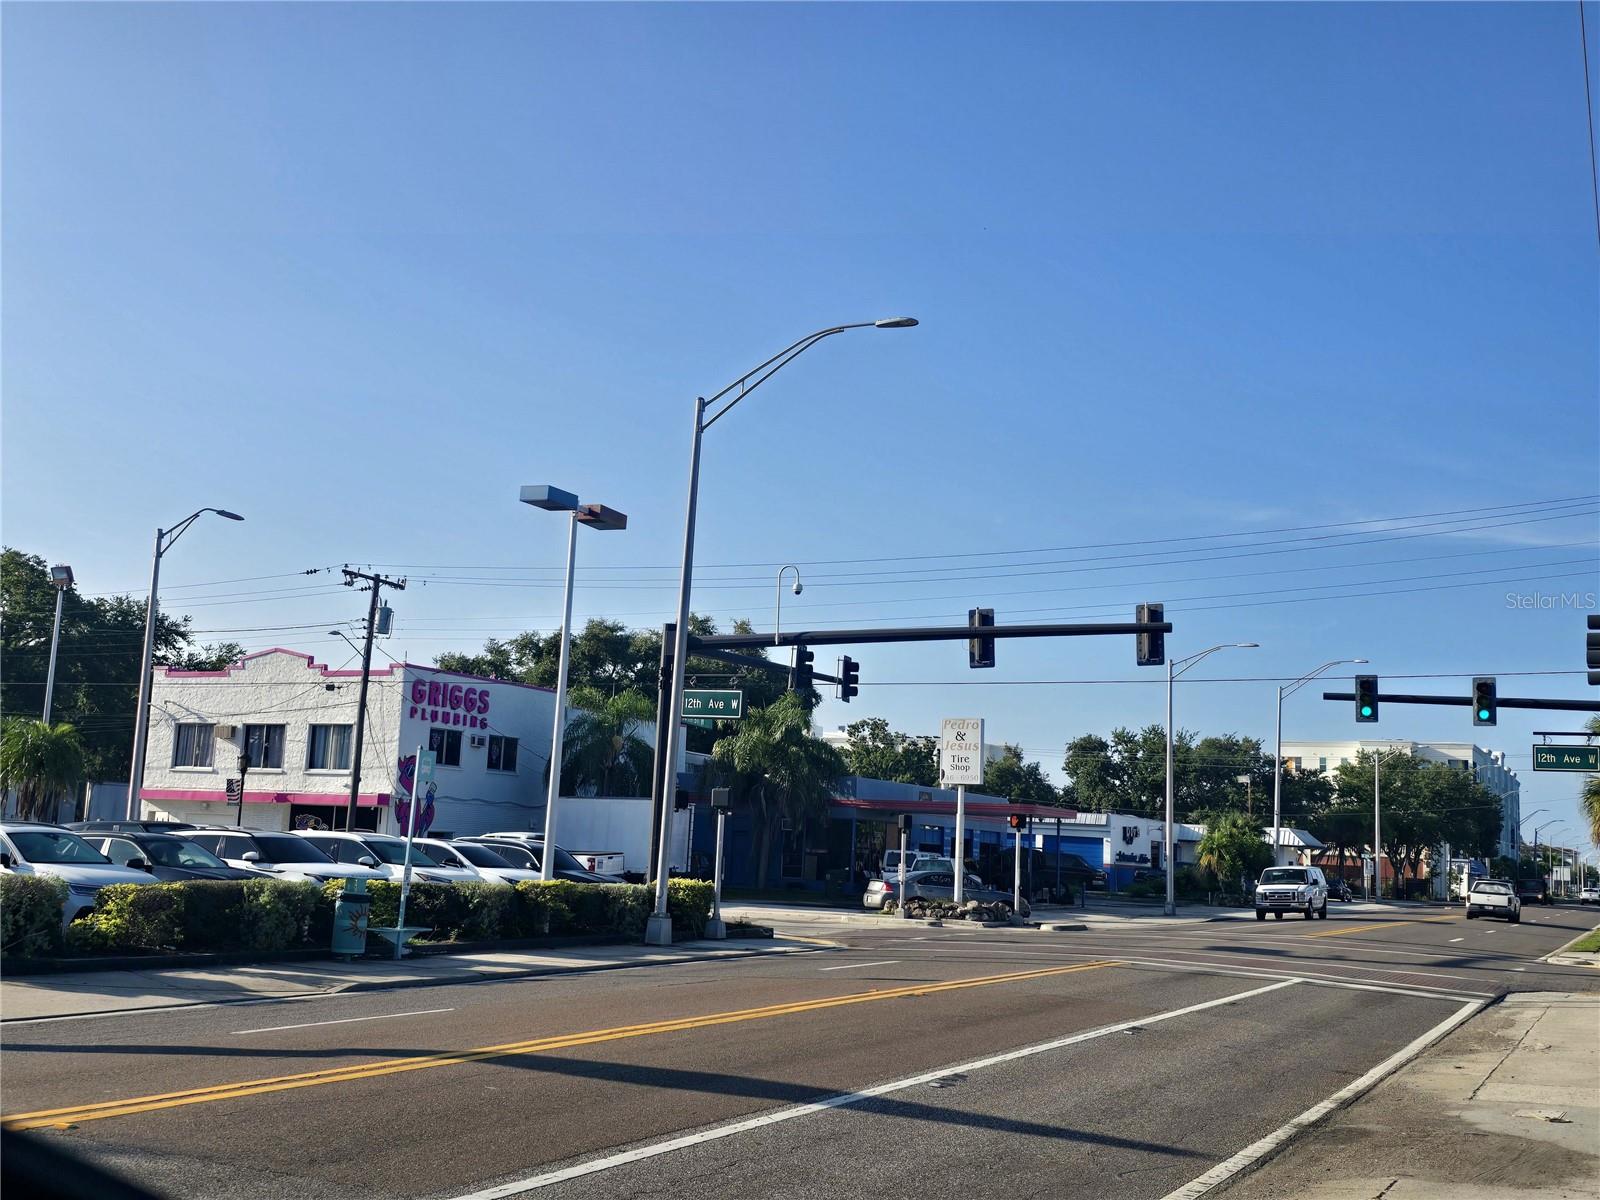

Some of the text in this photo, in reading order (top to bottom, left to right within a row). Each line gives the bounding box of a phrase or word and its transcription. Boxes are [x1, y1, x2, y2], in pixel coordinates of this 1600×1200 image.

[412, 679, 490, 714] GRIGGS
[685, 698, 739, 710] 12th Ave W
[410, 706, 487, 729] PLUMBING
[943, 719, 979, 730] Pedro
[955, 730, 966, 742] &
[943, 740, 979, 751] Jesus
[951, 754, 970, 763] Tire
[1537, 753, 1596, 764] 12th Ave W
[950, 763, 970, 772] Shop
